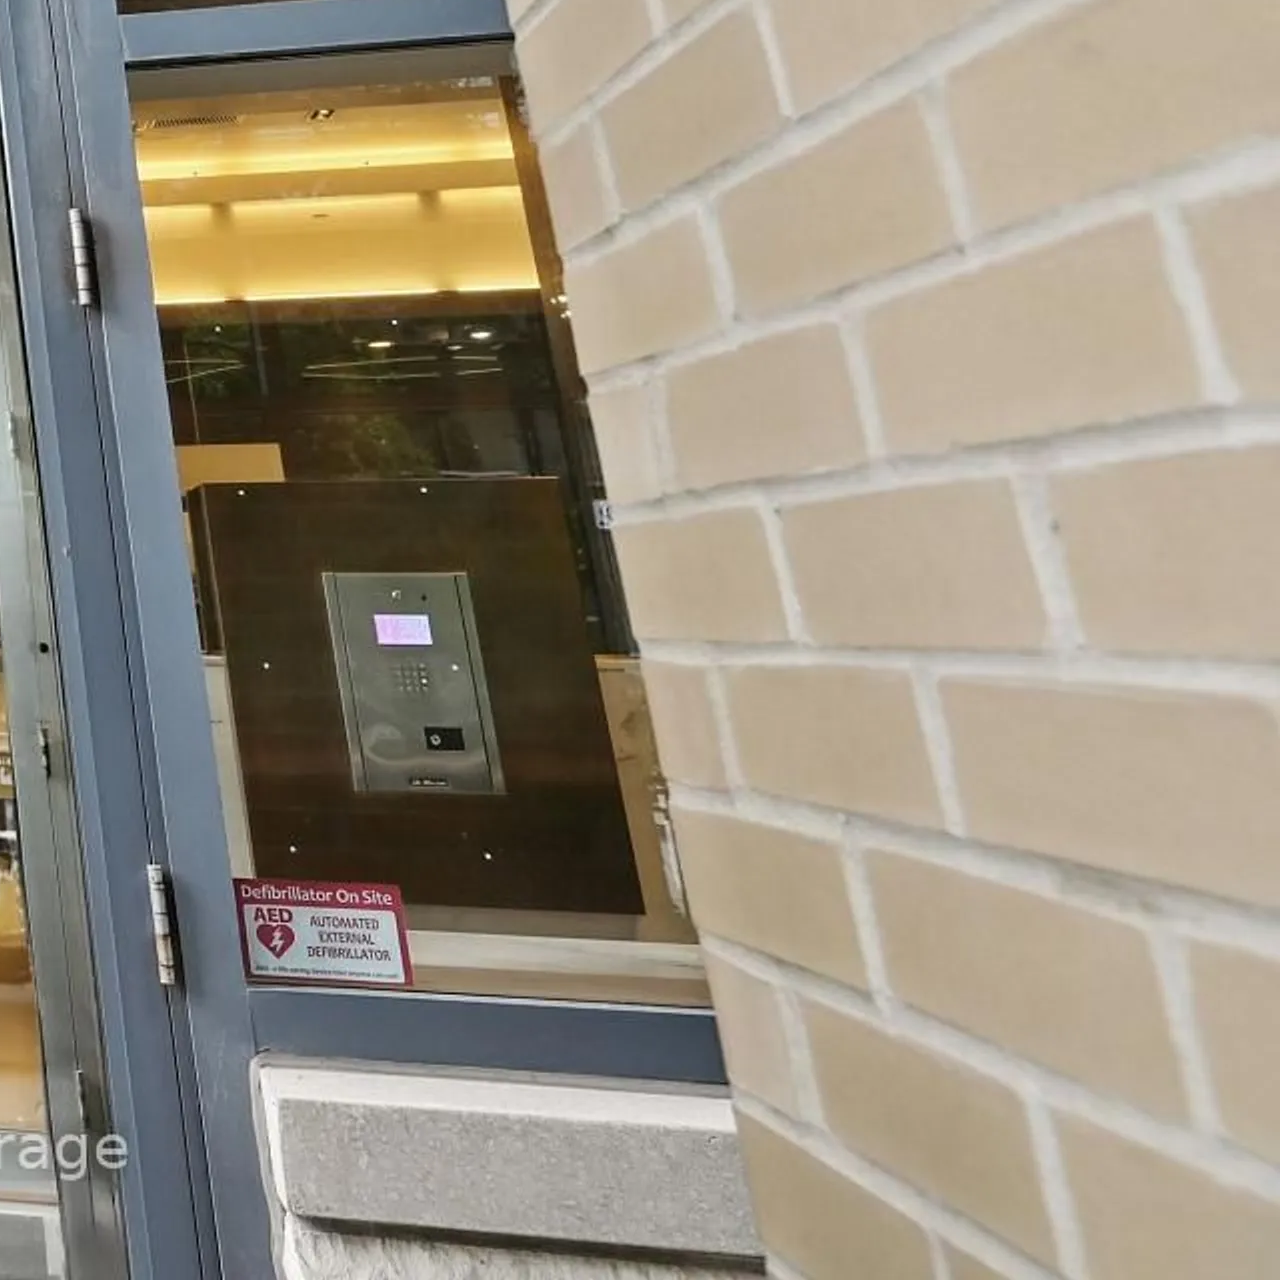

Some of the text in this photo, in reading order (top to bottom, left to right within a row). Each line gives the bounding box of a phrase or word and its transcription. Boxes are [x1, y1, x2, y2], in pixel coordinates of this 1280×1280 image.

[241, 884, 393, 905] Defibrillator On Site
[254, 907, 293, 923] AED
[310, 916, 379, 930] AUTOMATED
[319, 931, 375, 945] EXTERNAL
[307, 946, 391, 961] DEFIBRILLATOR
